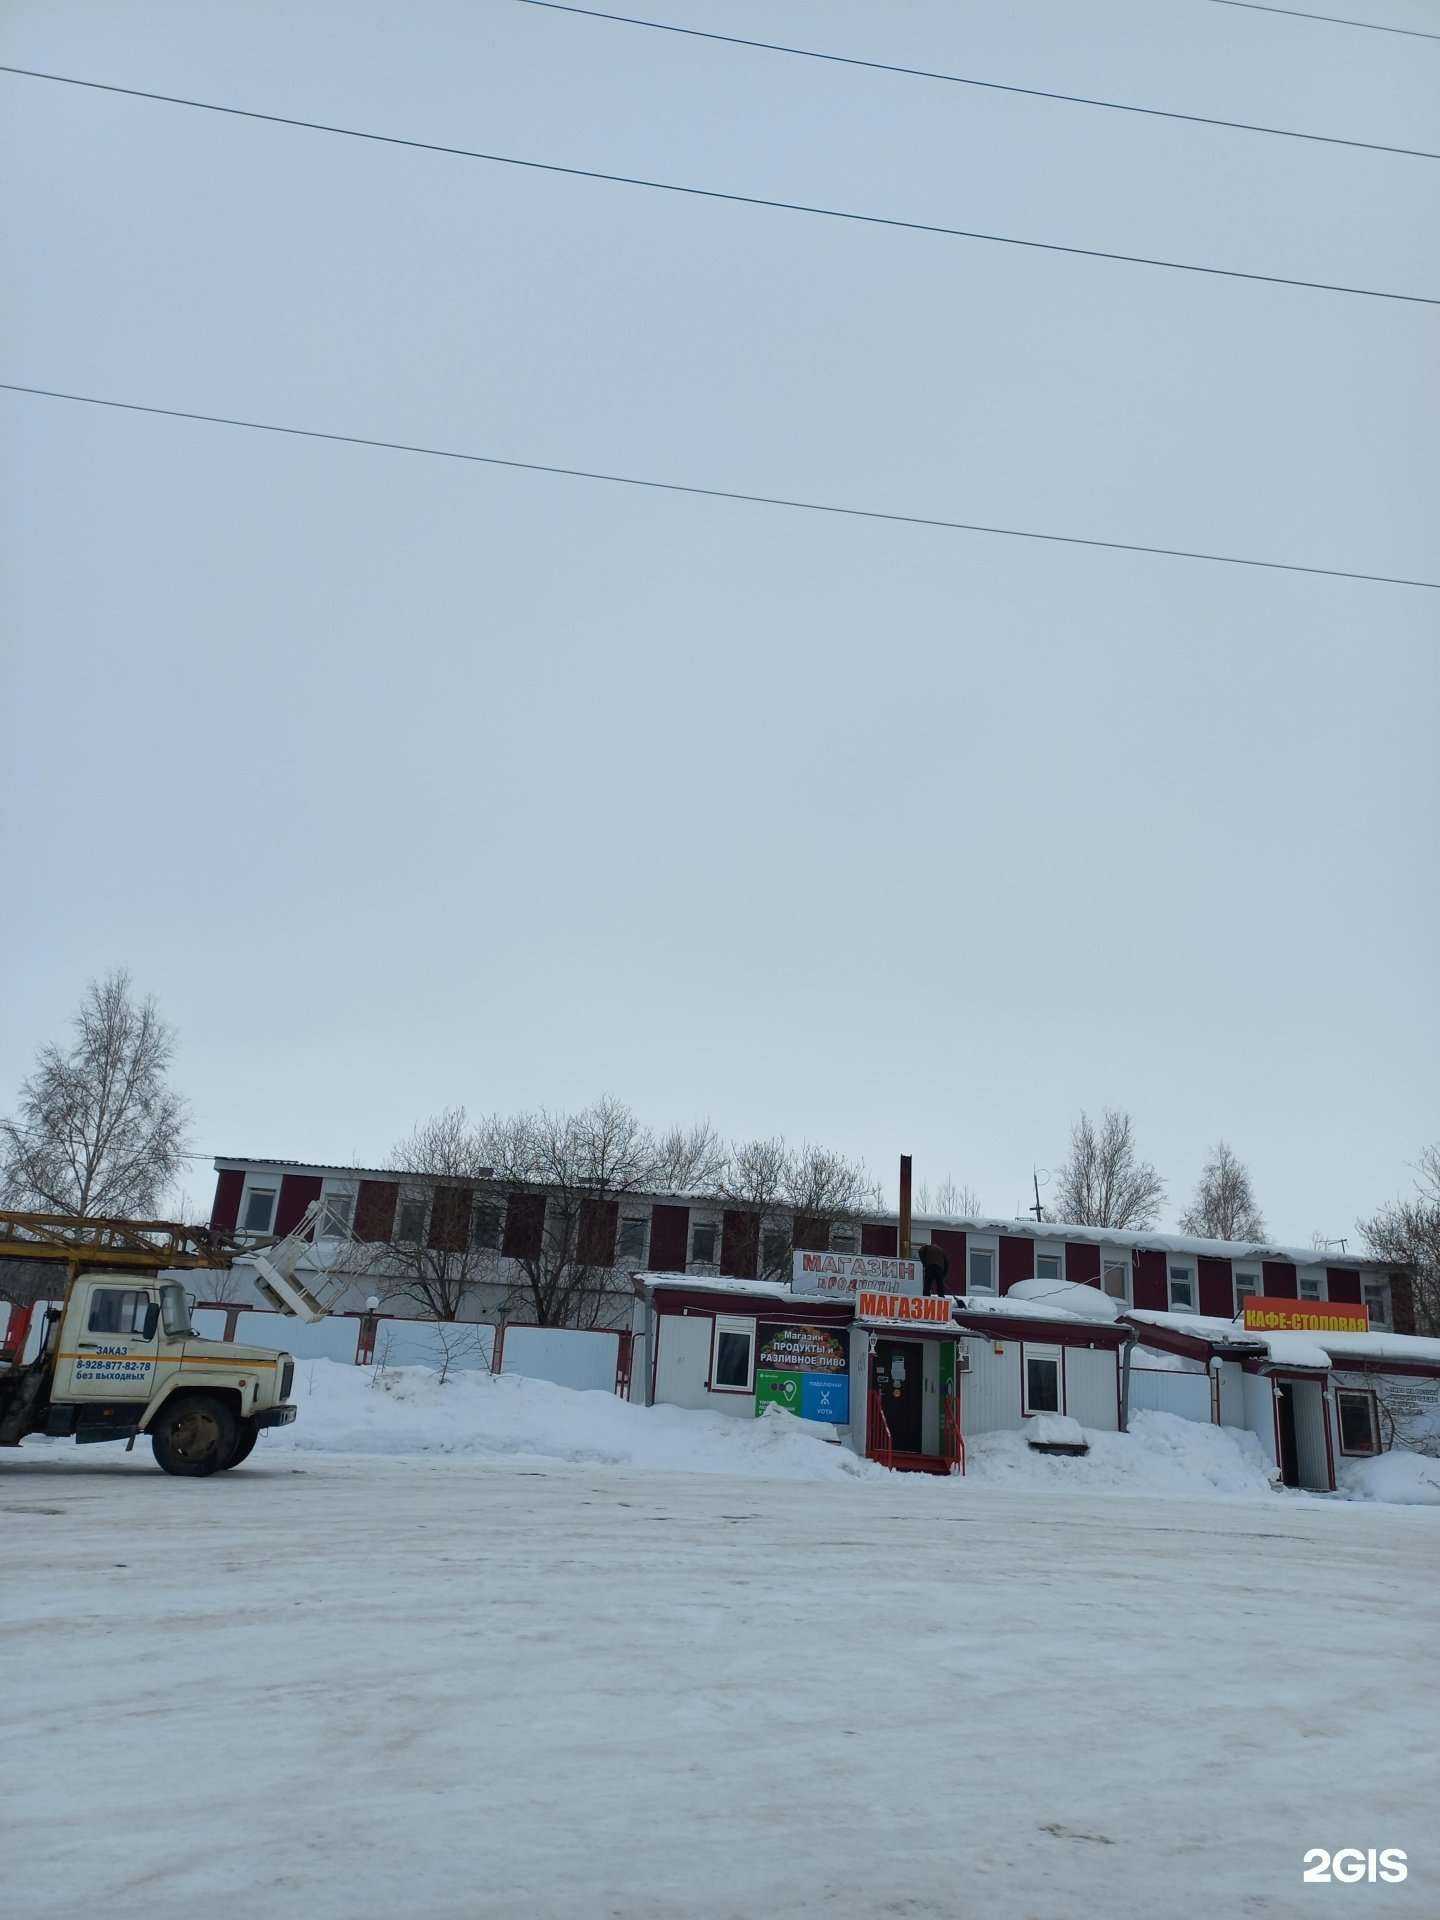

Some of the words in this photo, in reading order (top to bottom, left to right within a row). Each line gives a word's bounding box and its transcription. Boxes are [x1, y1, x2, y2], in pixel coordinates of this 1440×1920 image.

[803, 1253, 915, 1280] МАГАЗИН
[859, 1293, 950, 1322] МАГАЗИН
[784, 1330, 824, 1341] Магазин
[96, 1346, 128, 1356] ЗАКАЗ
[773, 1342, 825, 1353] ПРОДУКТЫ
[76, 1360, 151, 1371] 8-928-877-82-78
[760, 1353, 817, 1365] РАЗЛИВНОЕ
[819, 1357, 846, 1367] ПИВО
[76, 1370, 94, 1380] без
[95, 1371, 145, 1381] выходных
